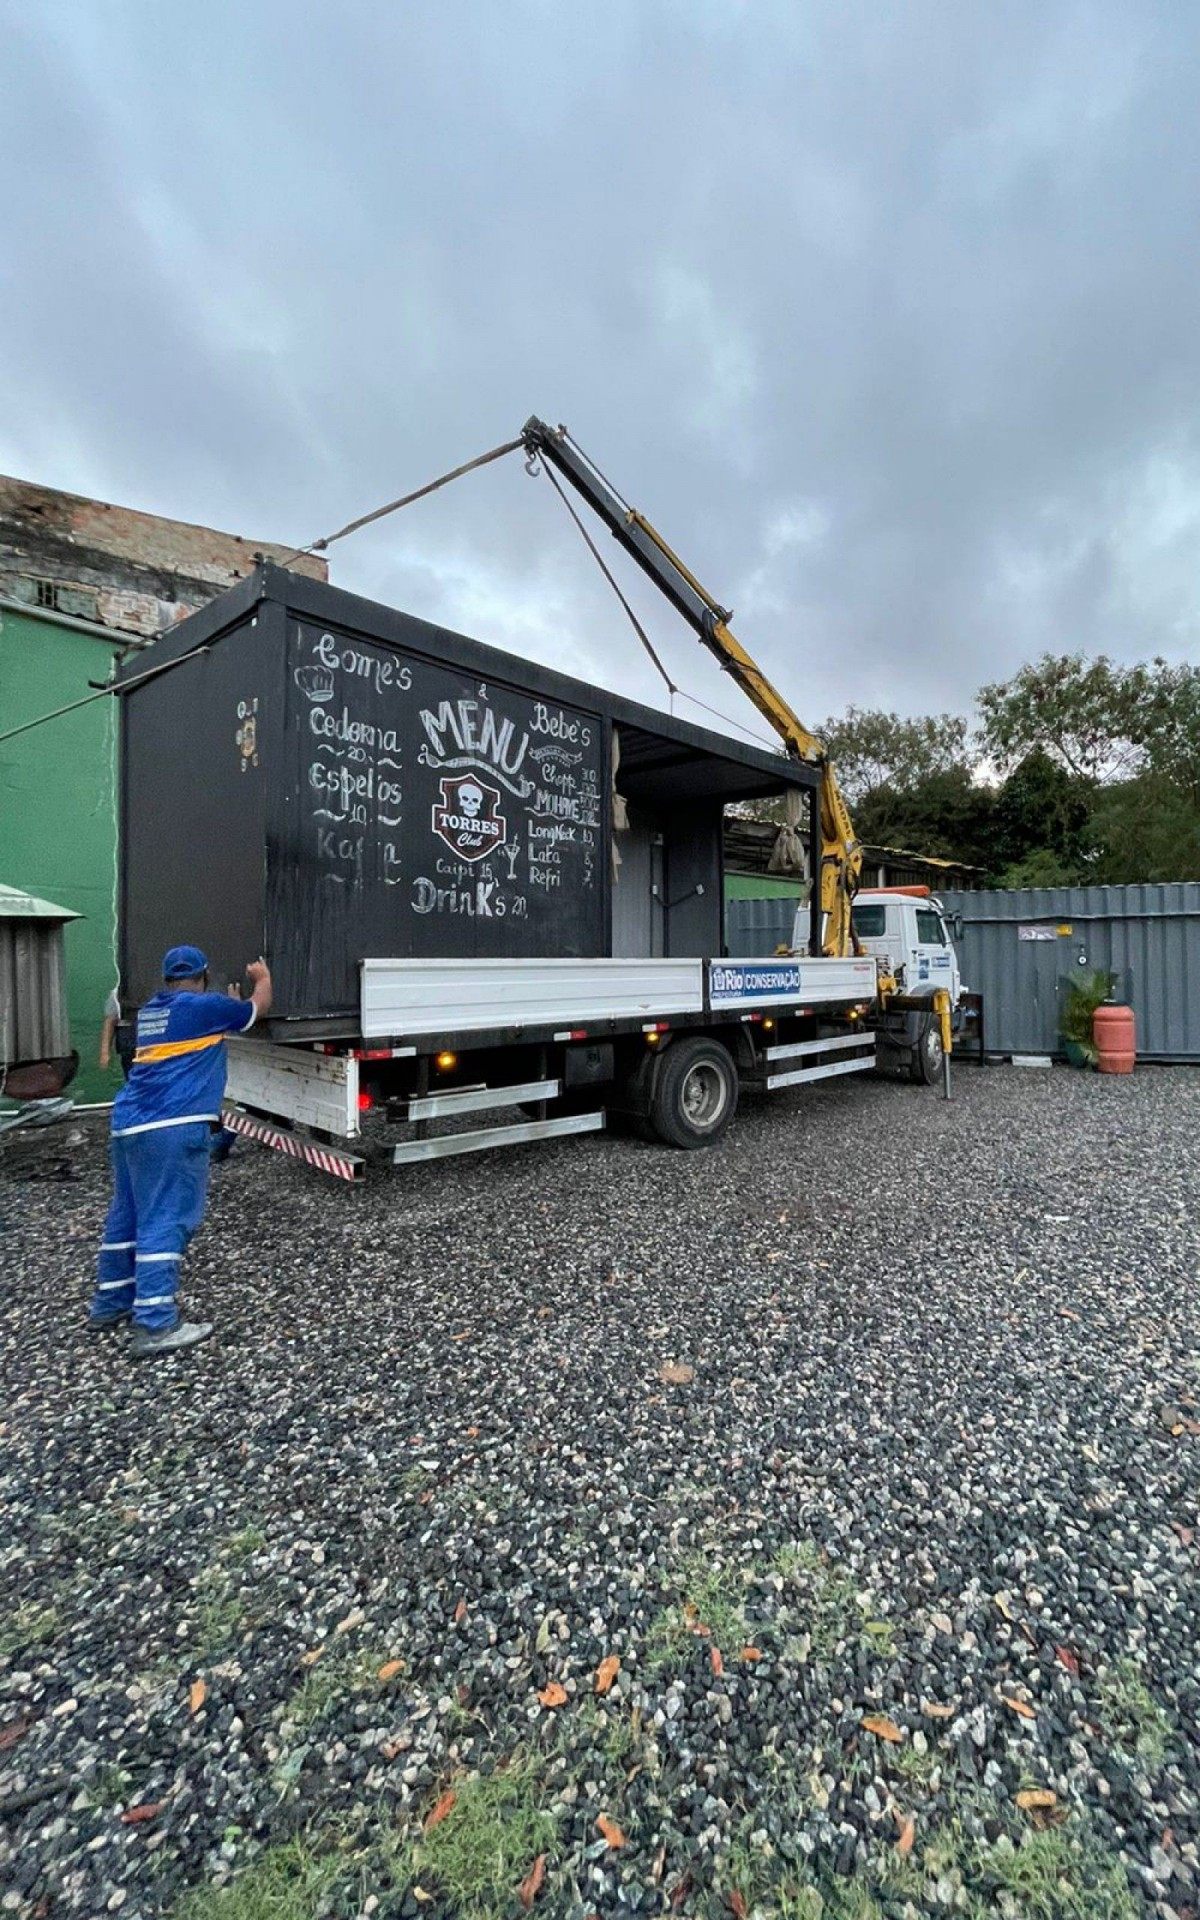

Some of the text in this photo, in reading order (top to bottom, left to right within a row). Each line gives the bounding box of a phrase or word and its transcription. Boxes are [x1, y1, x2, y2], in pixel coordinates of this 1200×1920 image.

[419, 700, 529, 774] MENU
[439, 813, 499, 836] TORRES
[457, 832, 484, 847] Club
[528, 842, 562, 864] Lata
[529, 865, 561, 892] Refri
[725, 969, 800, 991] Rio CONSERVAÇÃO
